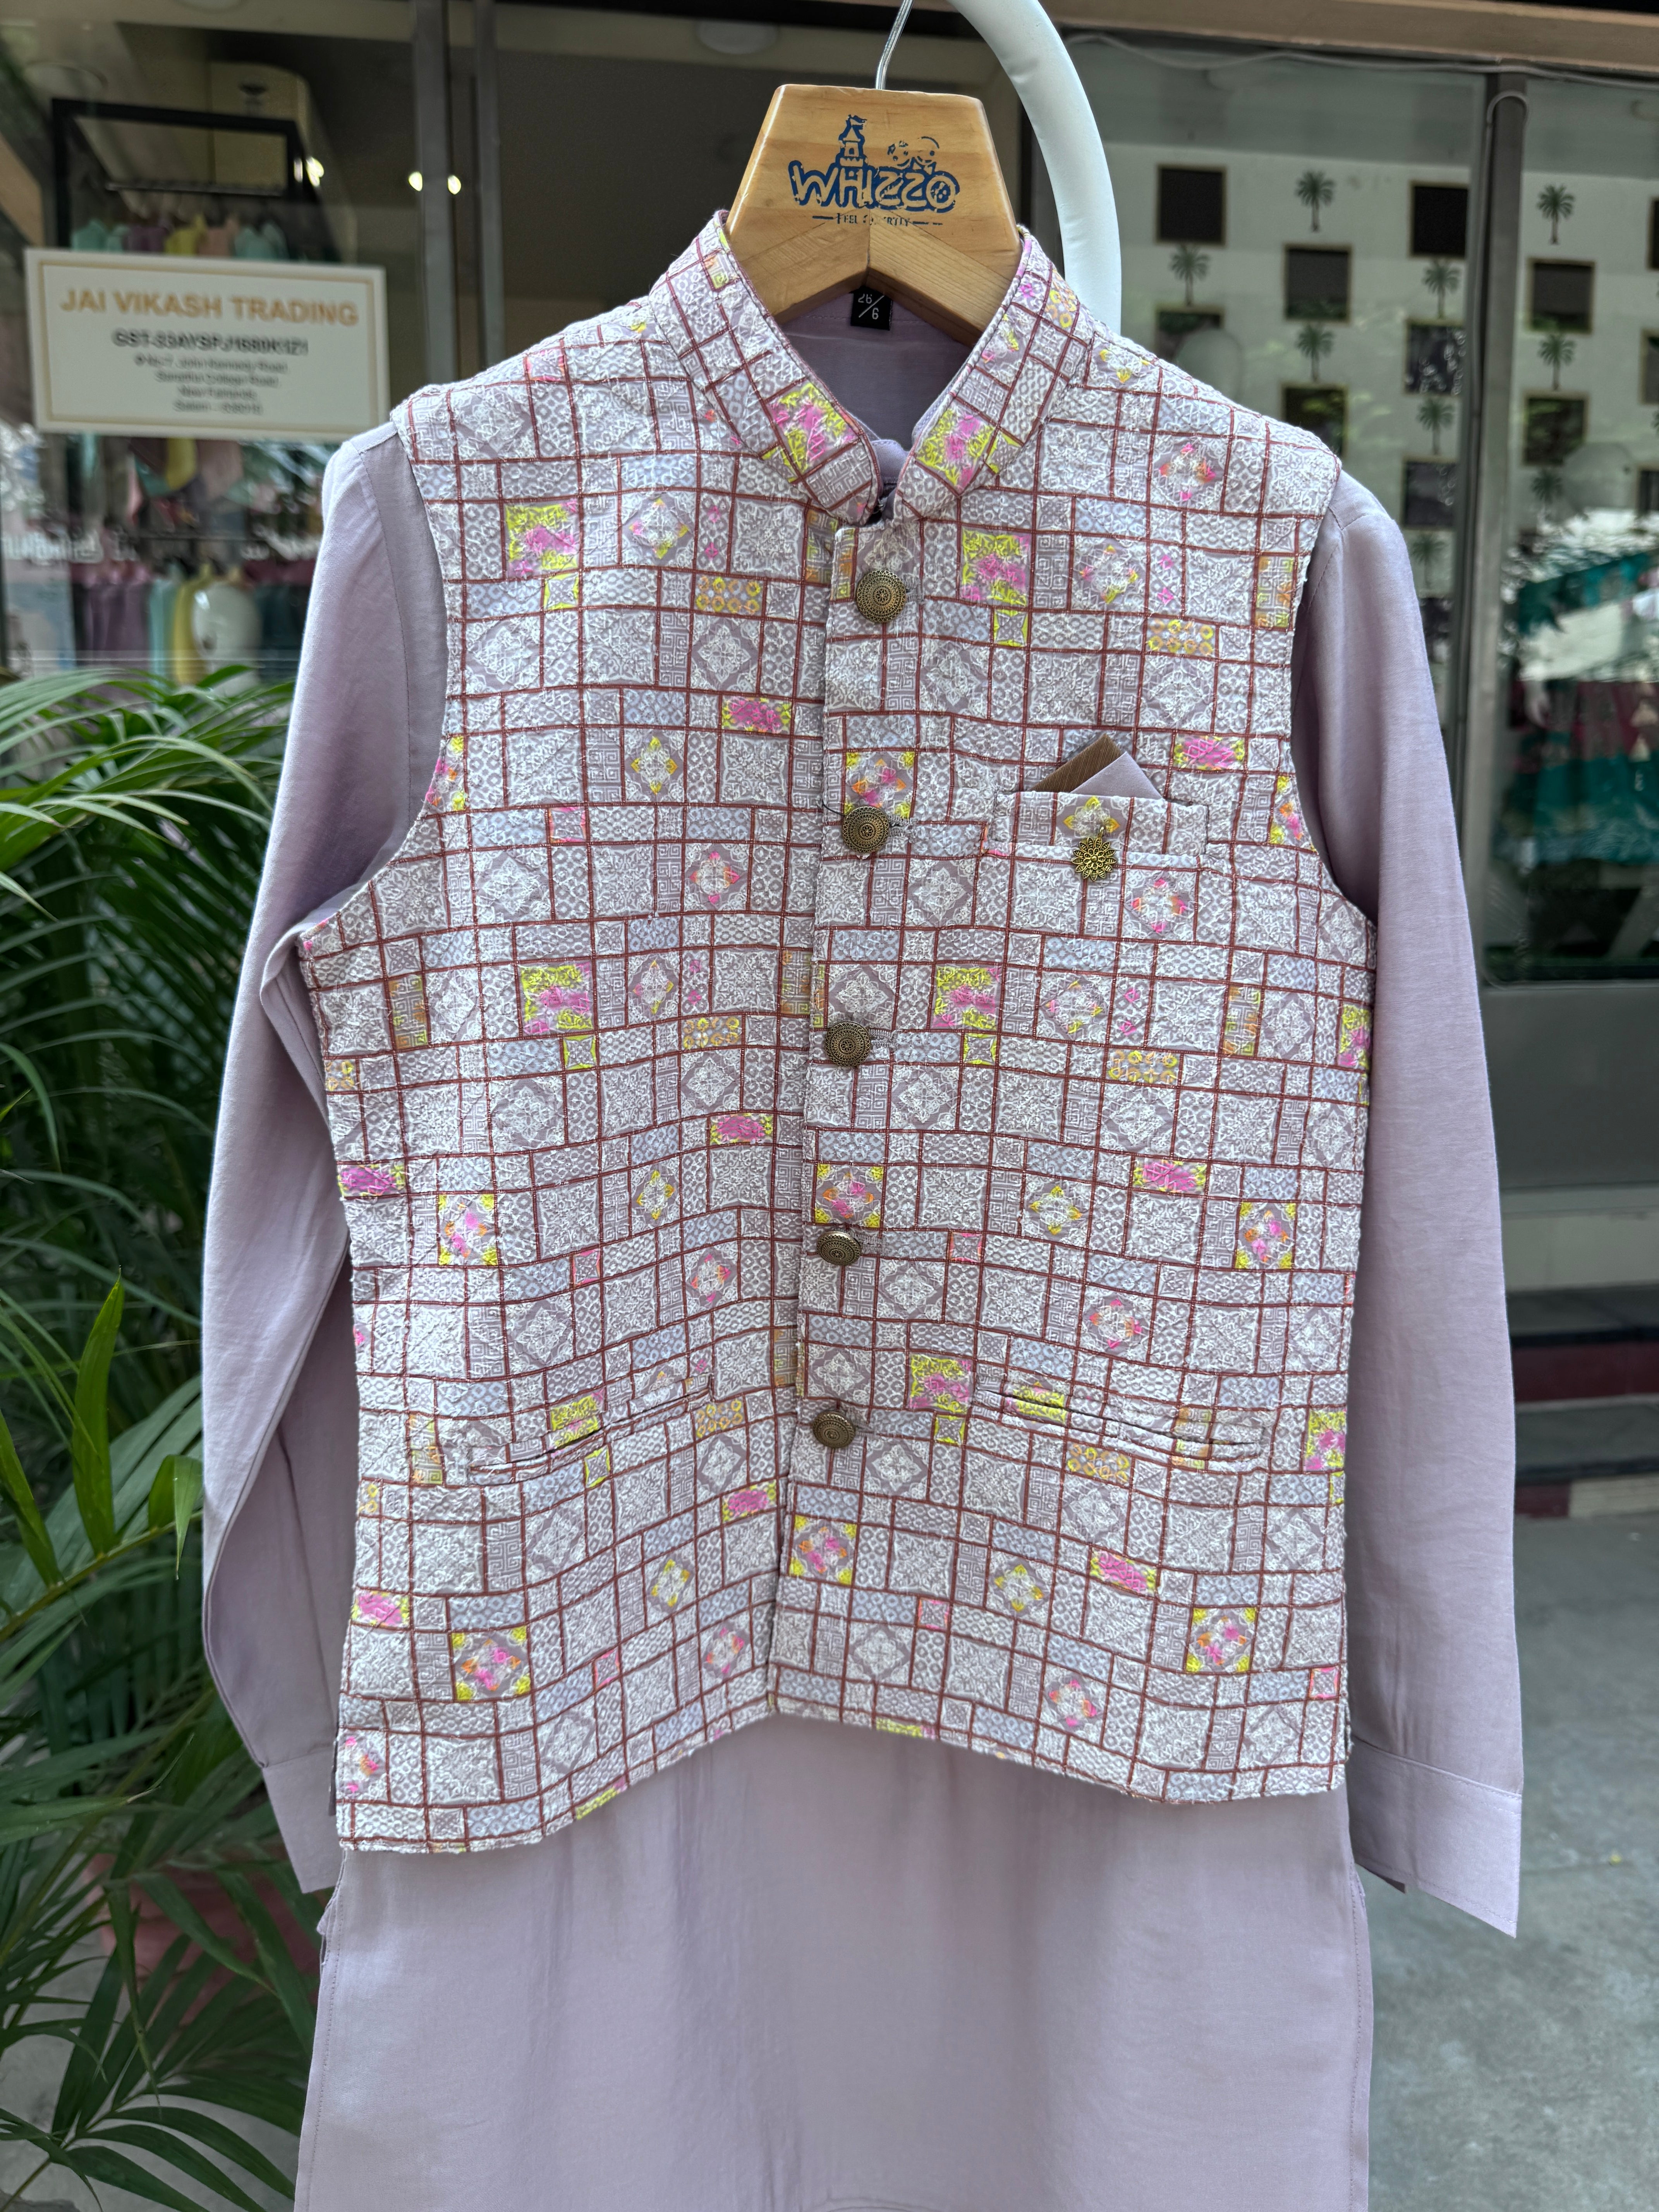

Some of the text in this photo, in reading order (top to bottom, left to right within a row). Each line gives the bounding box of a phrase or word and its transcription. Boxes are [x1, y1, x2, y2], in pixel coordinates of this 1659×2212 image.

[788, 160, 960, 213] WHIZZO
[60, 289, 360, 327] JAI VIKASH TRADING
